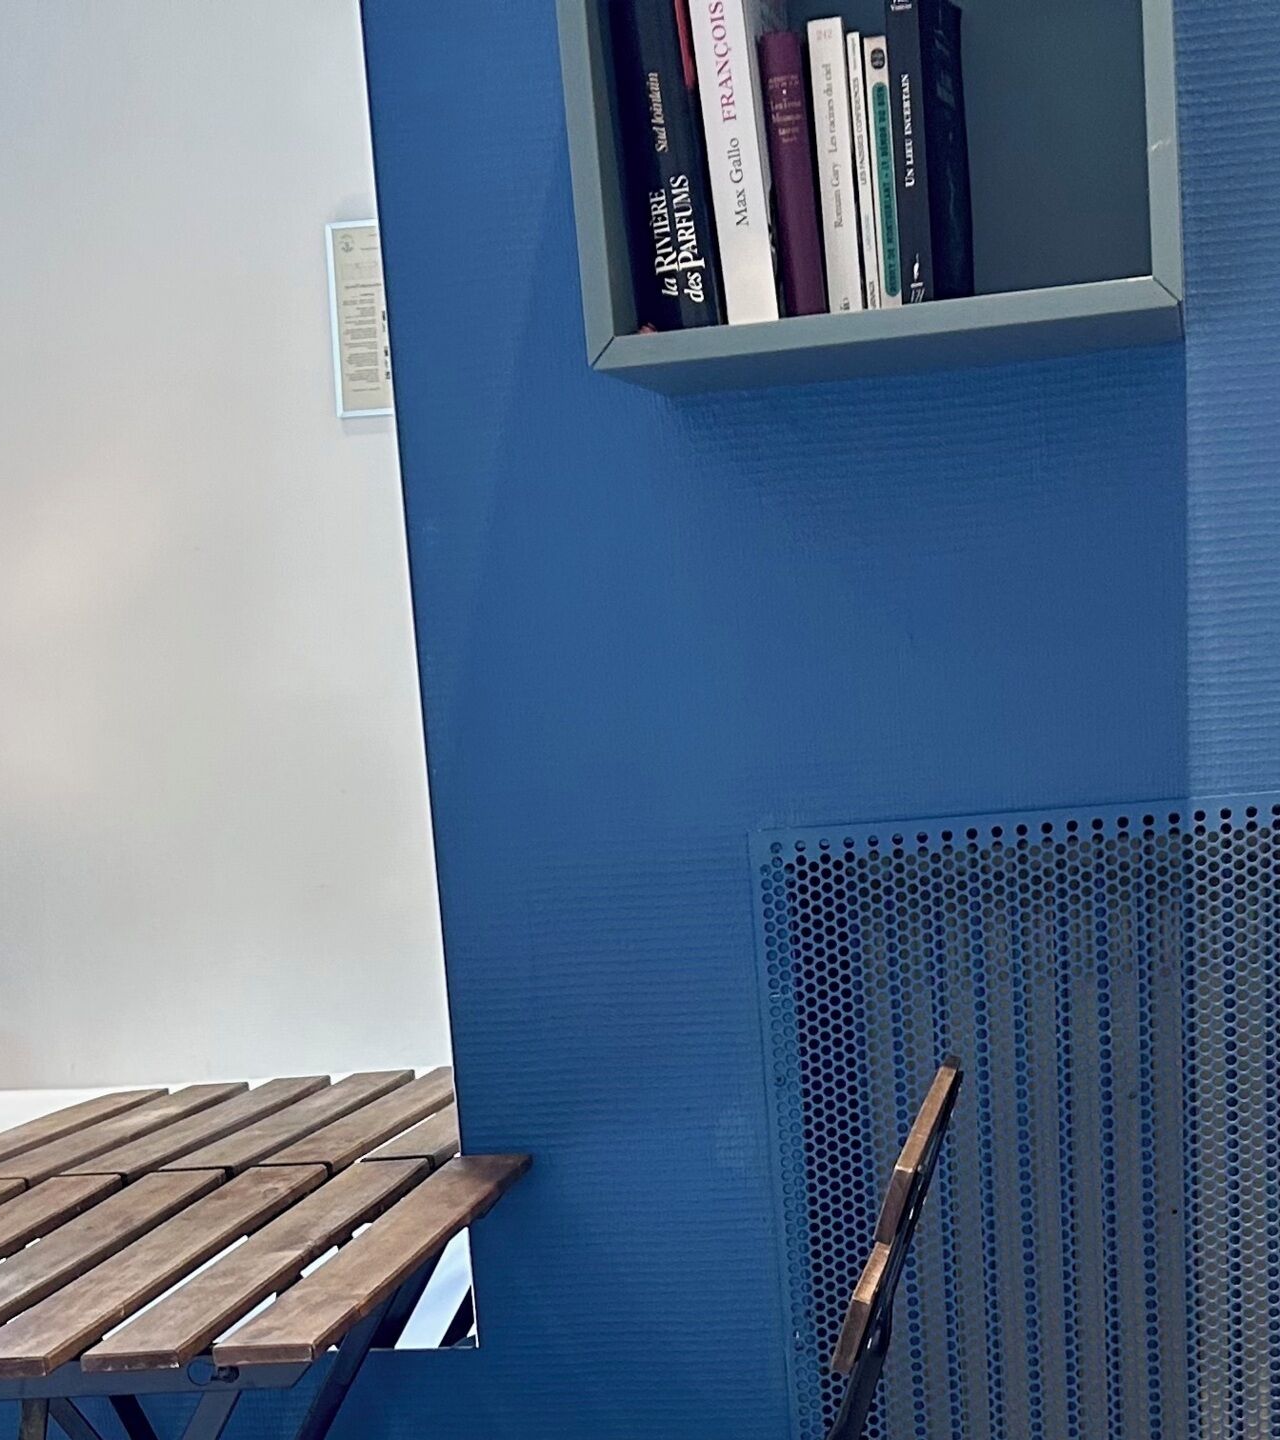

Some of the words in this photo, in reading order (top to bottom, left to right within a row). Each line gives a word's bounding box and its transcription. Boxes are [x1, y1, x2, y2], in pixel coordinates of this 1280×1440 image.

[708, 1, 737, 123] FRANÇOIS
[822, 63, 832, 81] ciel
[646, 72, 665, 124] lointain
[823, 83, 833, 96] du
[901, 73, 912, 135] INCERTAIN
[825, 99, 836, 133] racines
[652, 126, 669, 153] Sud
[828, 136, 838, 153] Les
[904, 138, 914, 165] LIEU
[727, 137, 745, 184] Gallo
[830, 162, 841, 187] Gary
[904, 168, 915, 188] UN
[669, 175, 706, 269] PARFUMS
[734, 187, 750, 228] Max
[833, 190, 844, 228] Romain
[648, 188, 679, 275] RIVIÈRE
[661, 278, 679, 296] la
[682, 272, 705, 303] des
